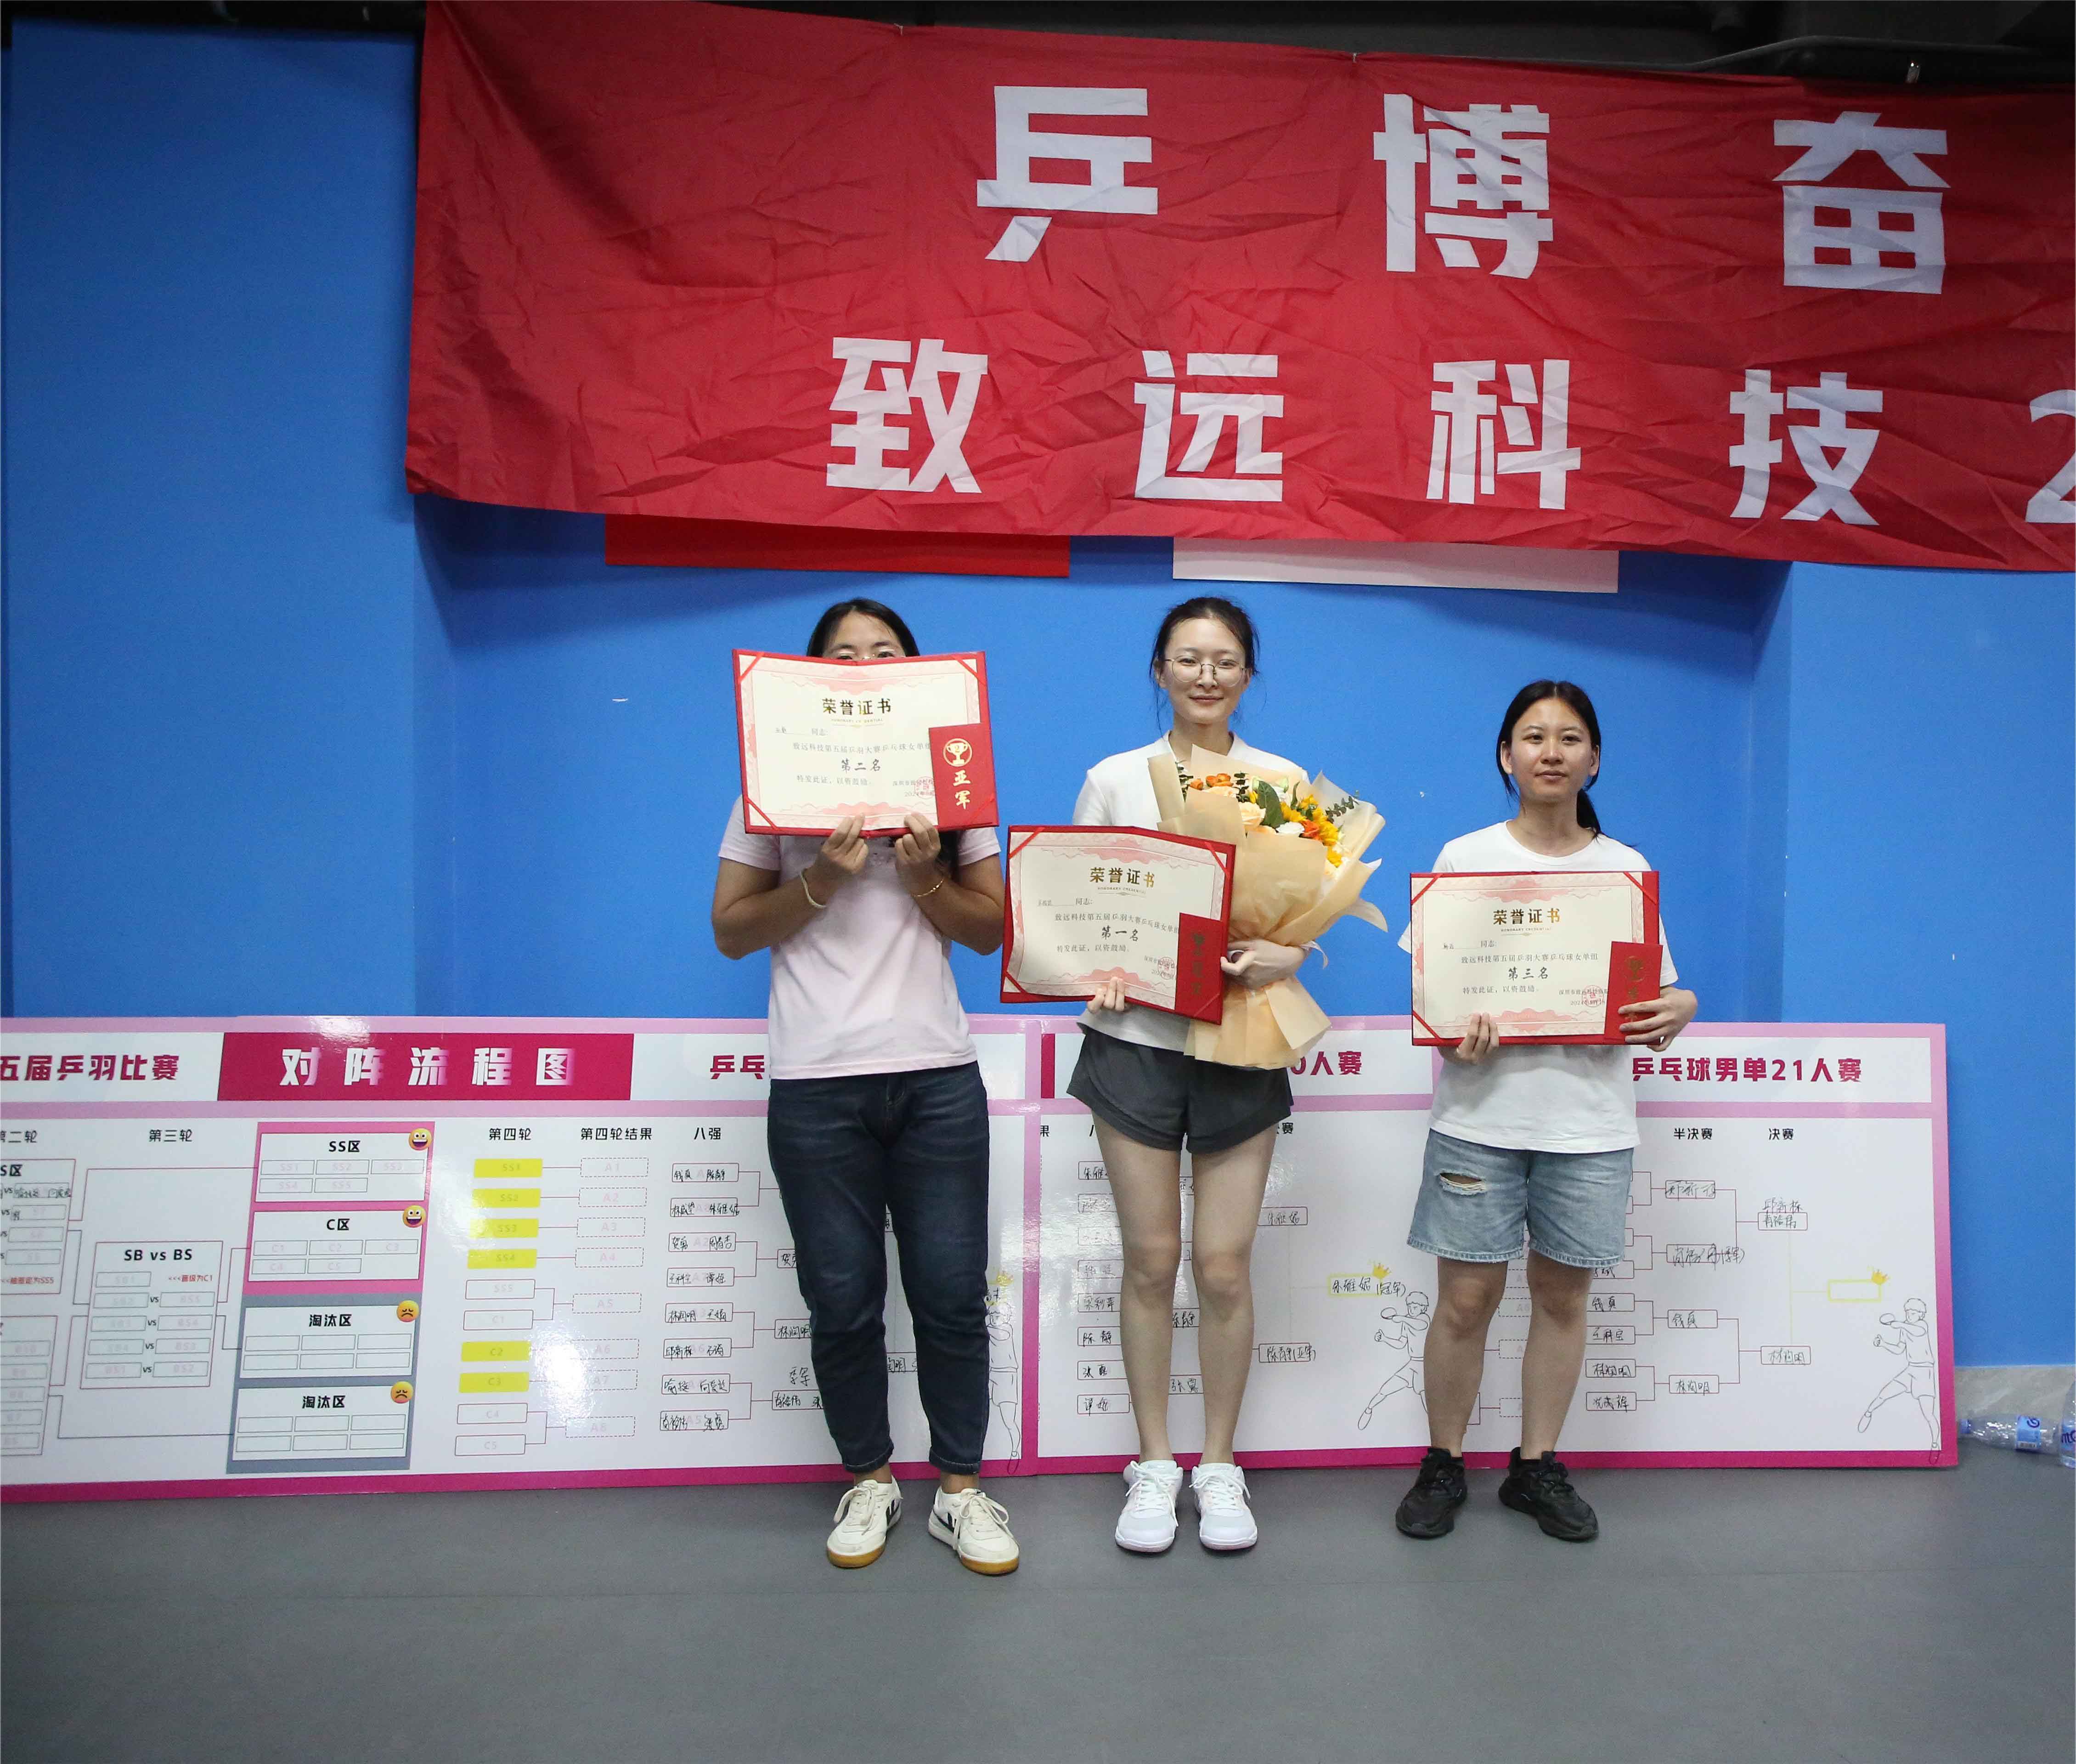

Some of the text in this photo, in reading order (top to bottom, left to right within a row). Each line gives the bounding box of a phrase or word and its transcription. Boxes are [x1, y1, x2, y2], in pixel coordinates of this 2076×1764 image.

[975, 85, 1951, 295] 乒博奋
[822, 698, 892, 716] 荣誉证书
[841, 758, 881, 772] 第二名
[953, 770, 971, 810] 亚军
[1090, 867, 1155, 888] 荣誉证书
[1493, 908, 1561, 925] 荣誉证书
[1100, 925, 1139, 942] 第一名
[1508, 967, 1548, 981] 第三名
[0, 1054, 180, 1081] 五届乒羽比赛
[280, 1046, 574, 1086] 对阵流程图
[1632, 1057, 1862, 1082] 乒乓球男单21人赛
[489, 1128, 532, 1141] 第四轮
[580, 1127, 653, 1141] 第四轮结果
[694, 1127, 722, 1140] 八强
[1277, 1122, 1294, 1135] 赛
[1674, 1127, 1713, 1141] 半决赛
[1768, 1128, 1794, 1141] 决赛
[148, 1129, 192, 1143] 第三轮
[328, 1140, 361, 1153] SS区
[503, 1163, 520, 1172] SS1
[605, 1162, 620, 1171] A1
[499, 1193, 519, 1202] SS2
[603, 1193, 619, 1202] A2
[326, 1218, 350, 1231] C区
[497, 1224, 517, 1233] SS3
[601, 1222, 617, 1232] A3
[124, 1249, 193, 1261] SB vs BS
[496, 1254, 515, 1263] SS4
[599, 1253, 616, 1262] A4
[597, 1299, 614, 1309] A5
[309, 1314, 352, 1327] 淘汰区
[492, 1316, 505, 1324] C1
[490, 1348, 503, 1357] C2
[488, 1377, 502, 1386] C3
[302, 1395, 346, 1409] 淘汰区
[486, 1410, 499, 1419] C4
[484, 1441, 497, 1450] C5
